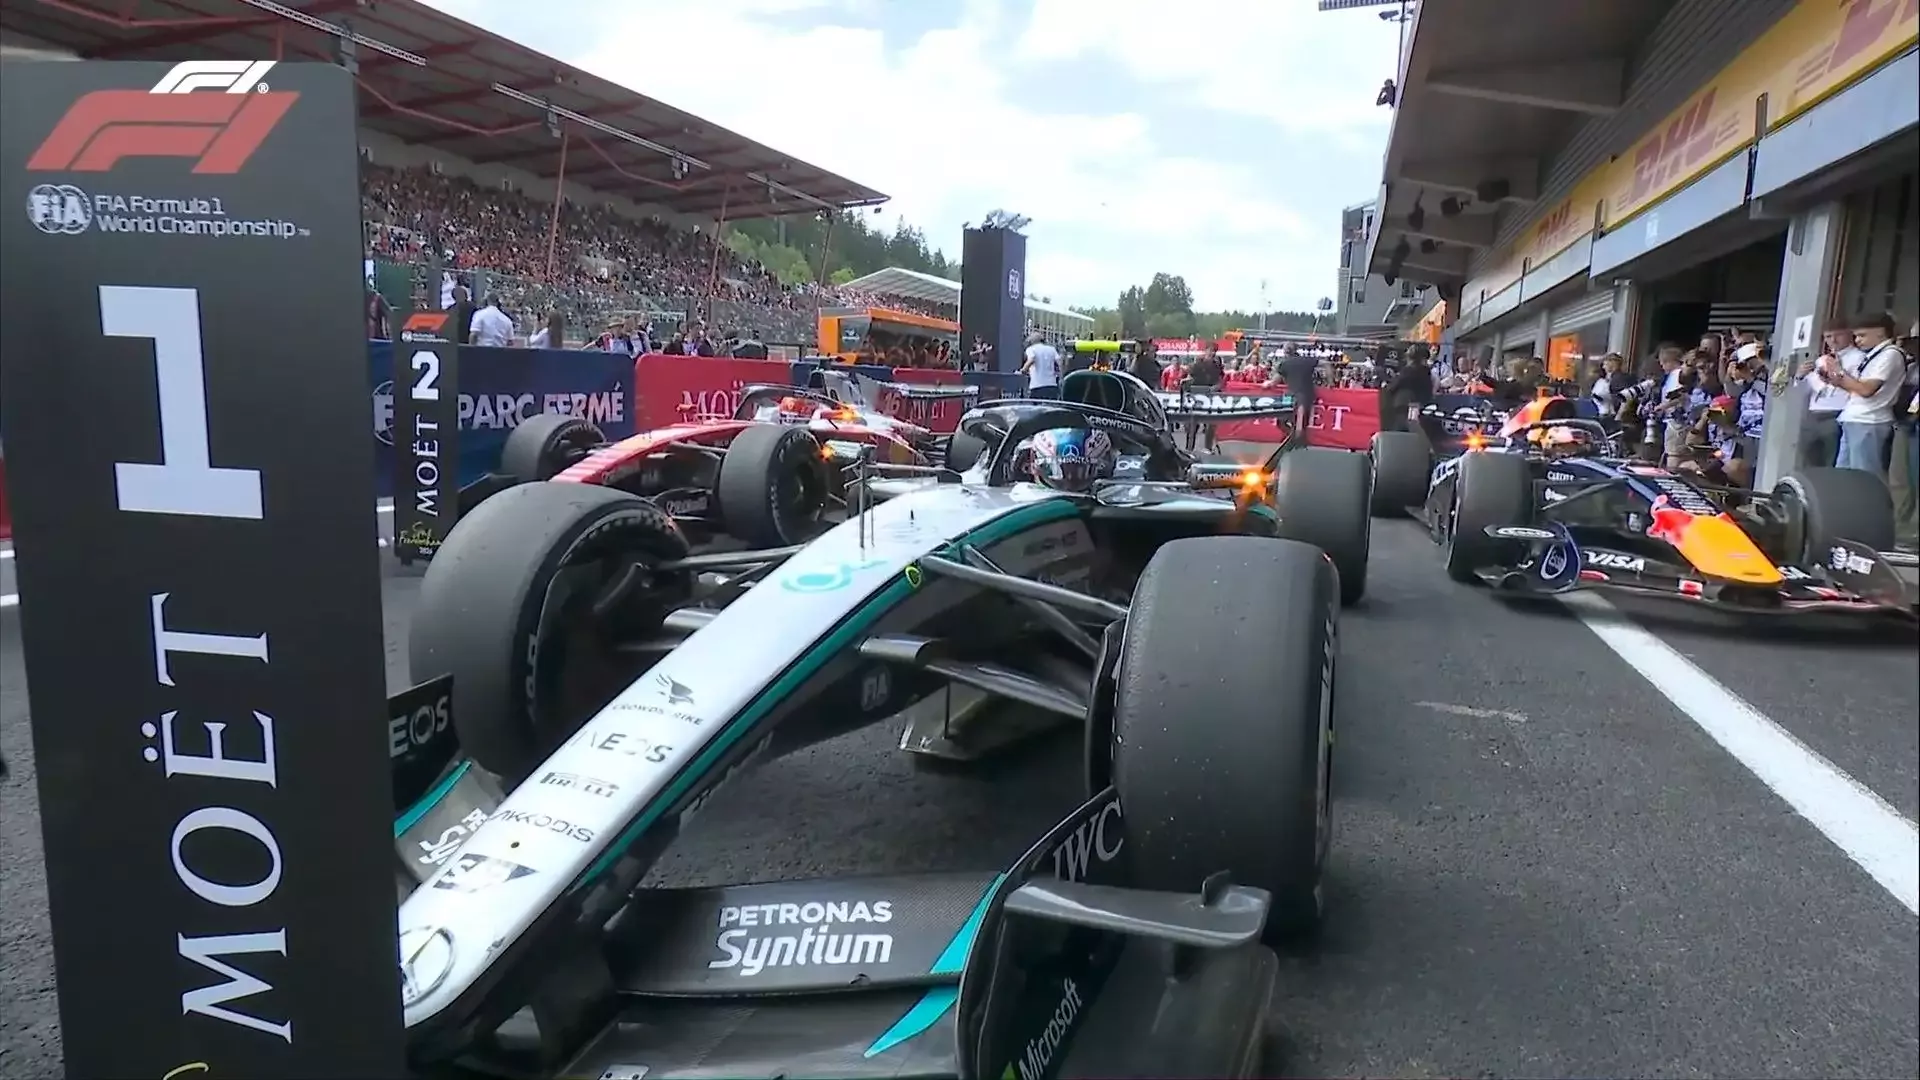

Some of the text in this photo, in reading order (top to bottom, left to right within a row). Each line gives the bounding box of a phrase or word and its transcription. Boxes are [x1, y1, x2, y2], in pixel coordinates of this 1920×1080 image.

[94, 194, 225, 215] FIA Formula 1
[97, 215, 156, 233] World
[157, 217, 297, 239] Championship
[411, 350, 439, 400] 2
[98, 284, 263, 519] 1
[457, 381, 624, 432] PARC FERMÉ
[412, 413, 439, 517] MOËT
[1584, 550, 1645, 572] VISA
[388, 694, 449, 758] EOS
[539, 772, 620, 799] PIRLLI
[142, 592, 293, 1044] MOËT
[1052, 797, 1124, 884] IWC
[719, 900, 893, 928] PETRONAS
[708, 924, 893, 977] Syntium
[1018, 976, 1082, 1080] Microsoft
